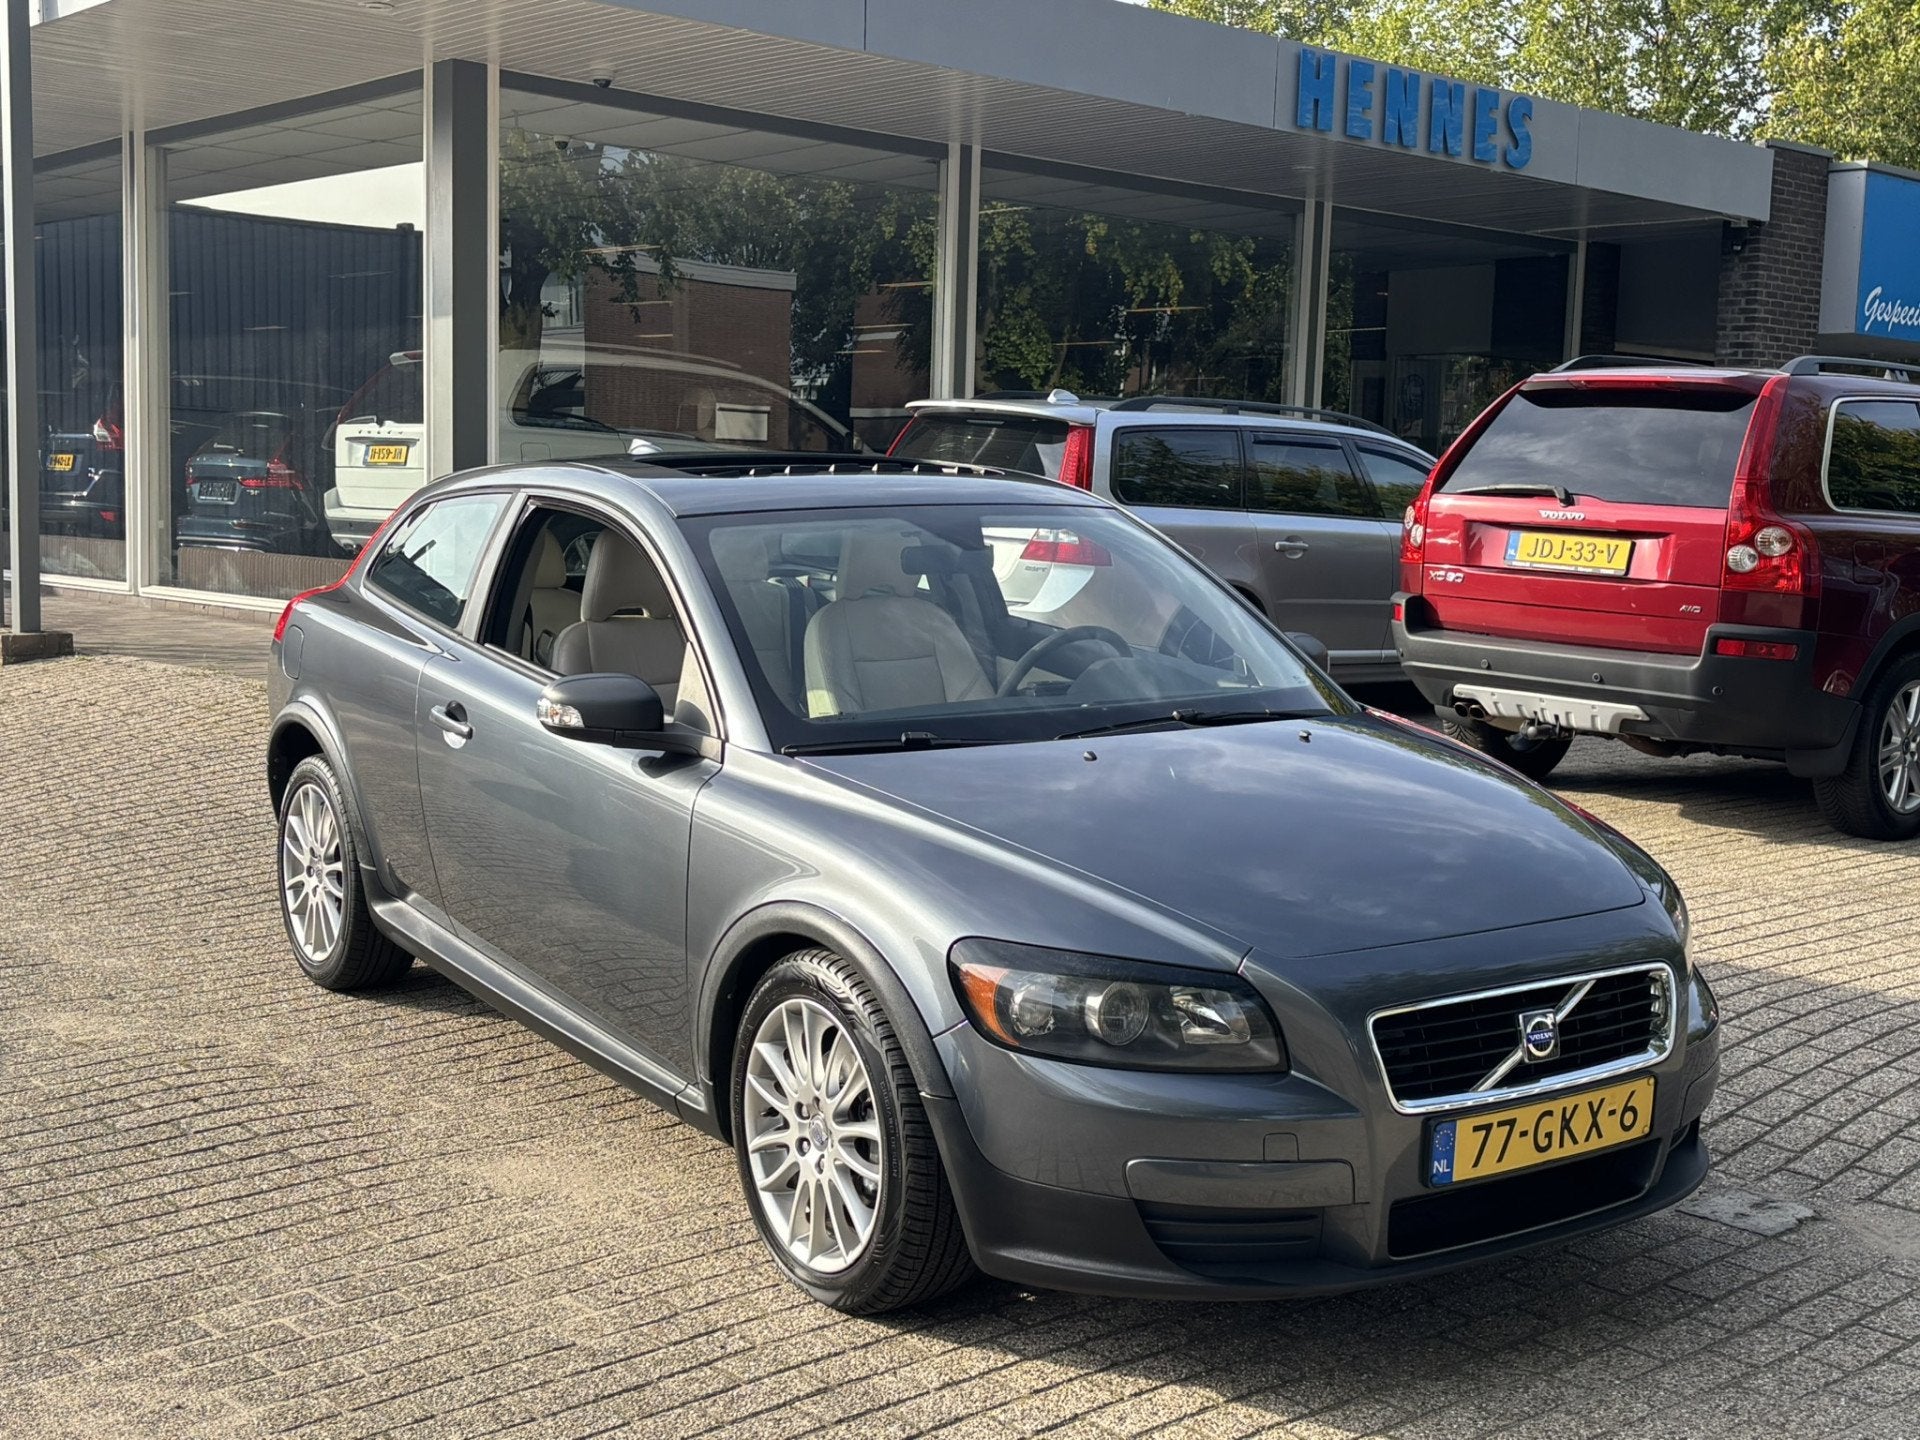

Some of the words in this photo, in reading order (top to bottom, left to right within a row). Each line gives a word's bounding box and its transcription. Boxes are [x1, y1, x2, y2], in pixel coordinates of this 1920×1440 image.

[1297, 48, 1533, 169] HENNES
[1539, 510, 1585, 521] VOLVO
[1527, 538, 1619, 564] JDJ-33-V
[1529, 1031, 1554, 1041] VOLVO
[1471, 1089, 1638, 1168] 77-GKX-6
[1433, 1160, 1451, 1174] NL
